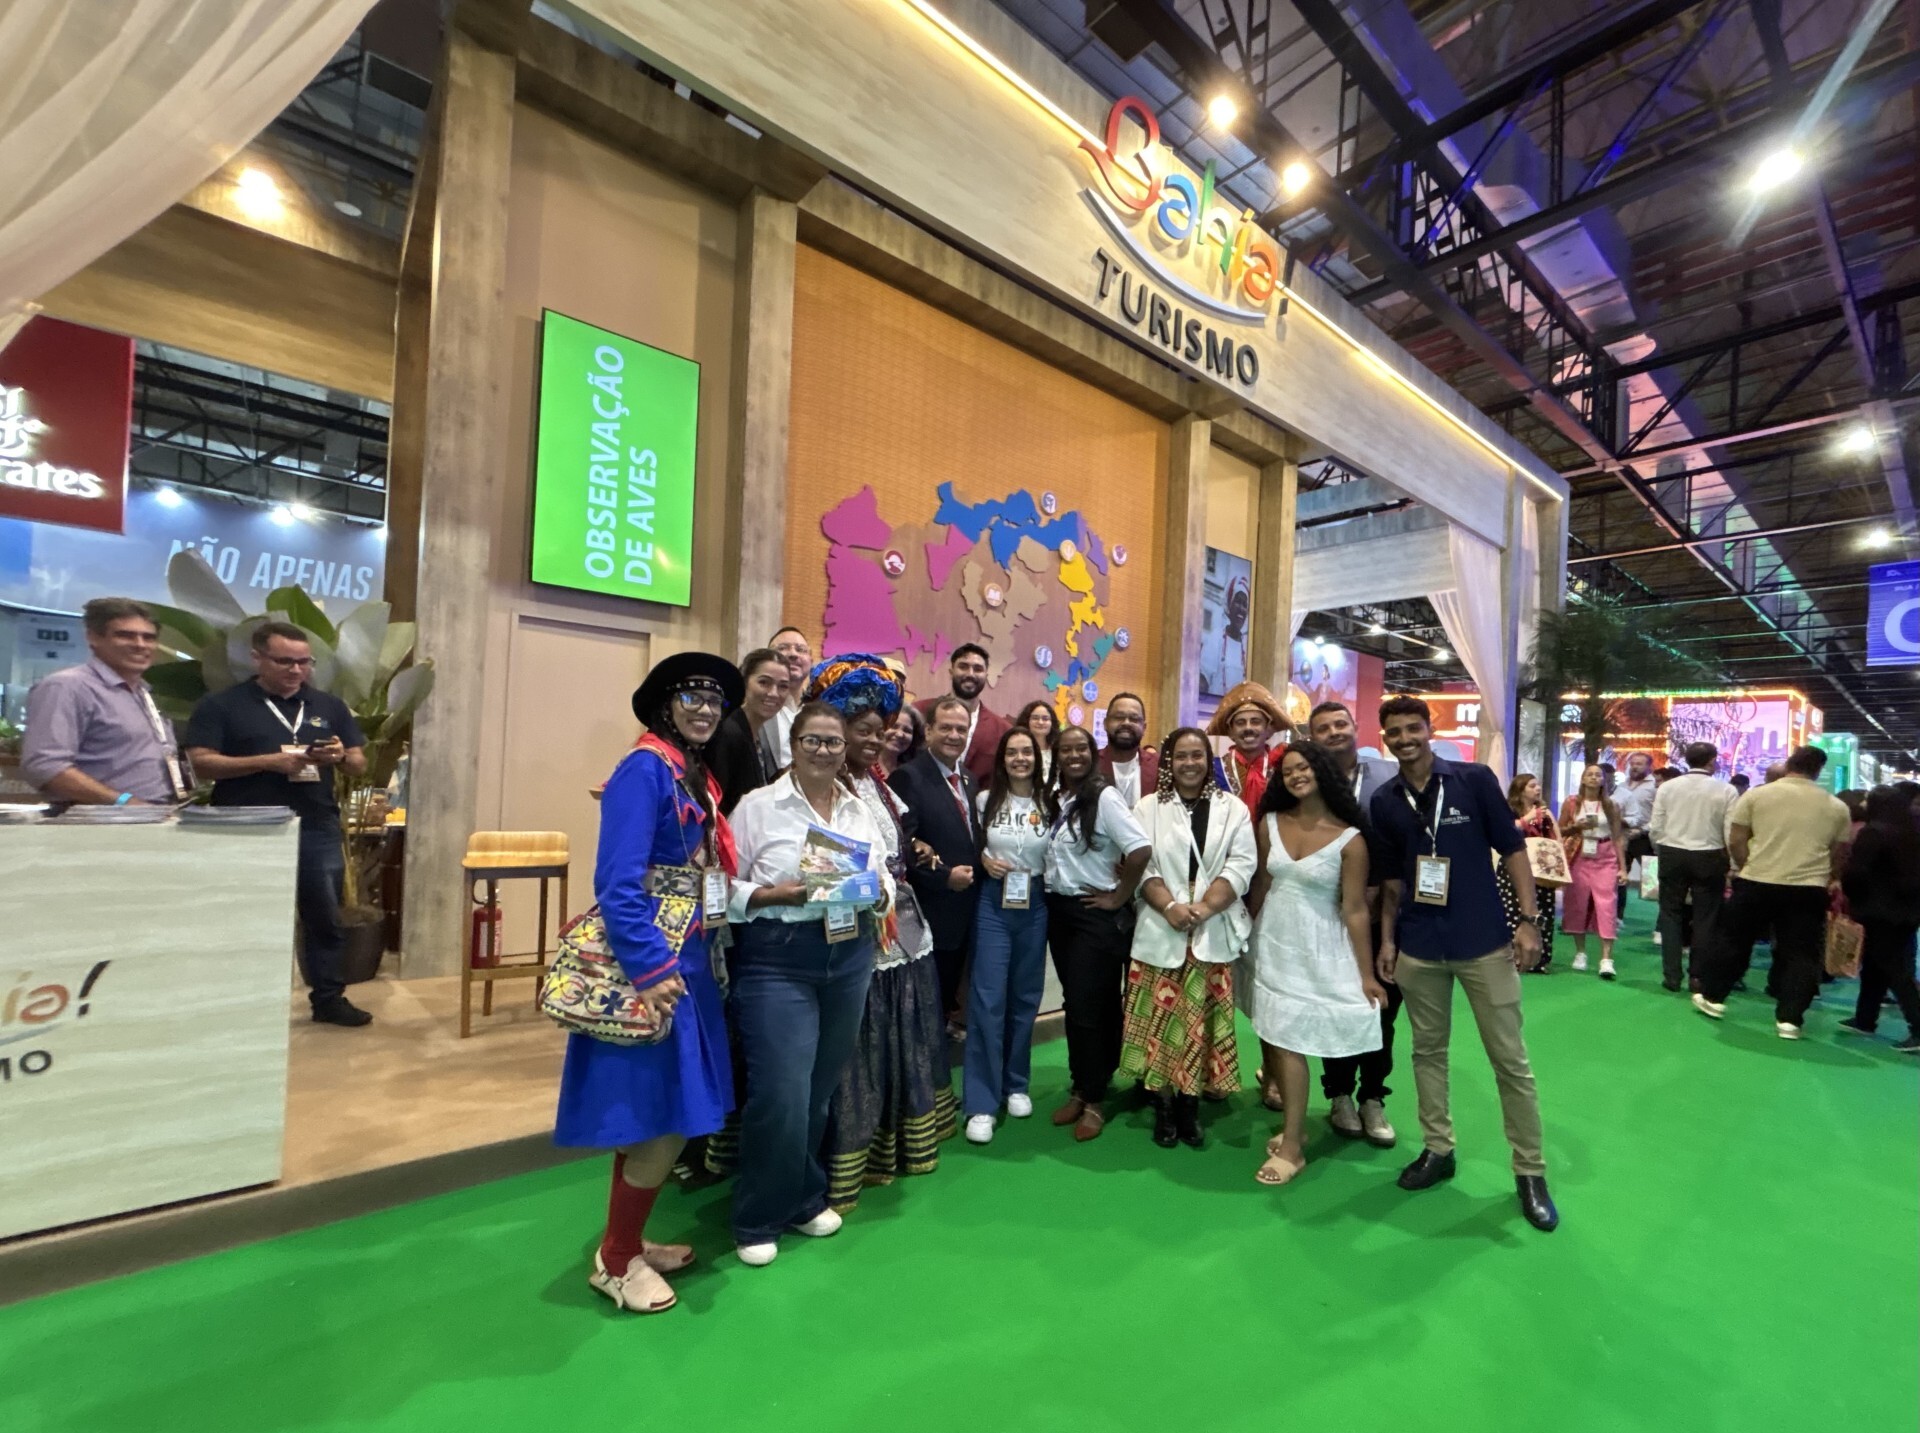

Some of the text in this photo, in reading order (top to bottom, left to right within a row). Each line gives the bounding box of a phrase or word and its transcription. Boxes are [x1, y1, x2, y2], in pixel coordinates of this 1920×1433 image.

[1096, 246, 1260, 386] TURISMO
[585, 344, 630, 579] OBSERVAÇÃO
[624, 446, 658, 586] DE AVES
[249, 551, 374, 600] APENAS
